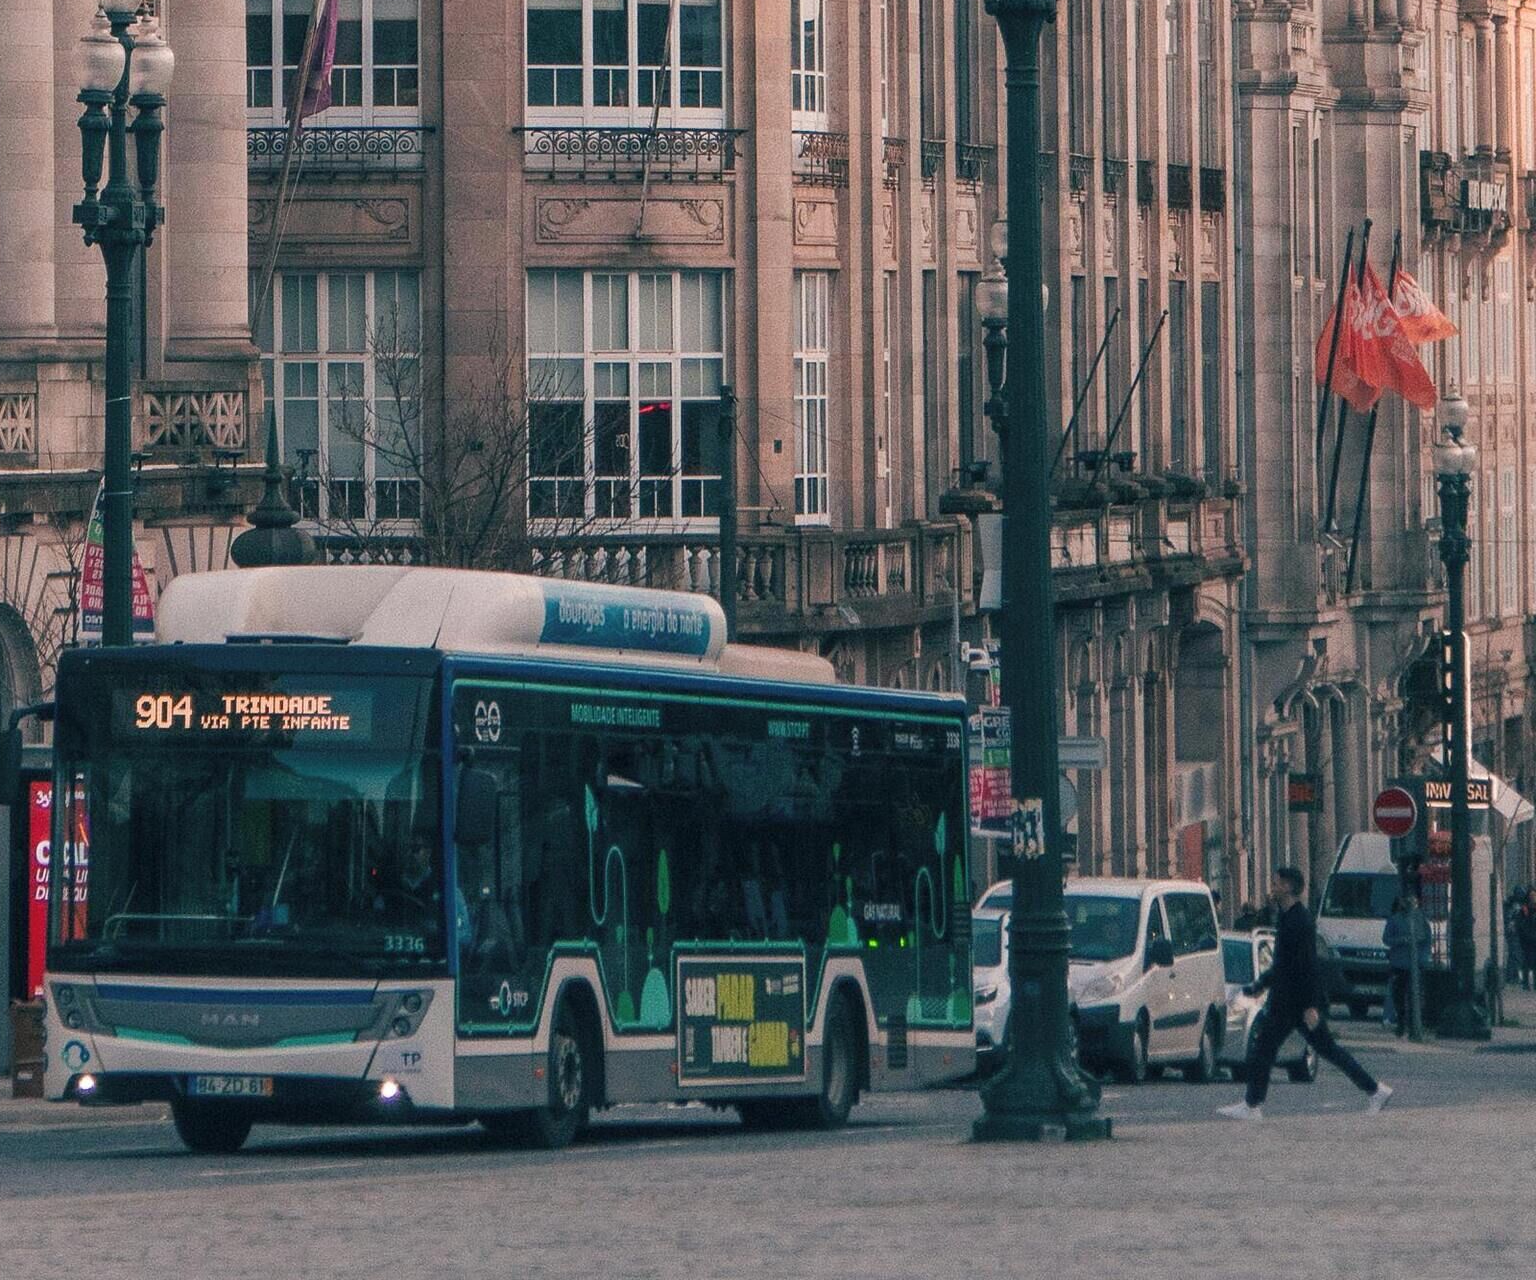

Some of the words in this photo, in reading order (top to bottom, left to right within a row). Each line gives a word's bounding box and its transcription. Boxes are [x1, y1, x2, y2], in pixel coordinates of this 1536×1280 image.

[136, 695, 193, 730] 904
[221, 695, 332, 715] TRINDADE
[201, 715, 229, 730] VIA
[241, 715, 270, 730] PTE
[282, 715, 350, 731] INFANTE
[384, 934, 425, 953] 3336
[201, 1012, 261, 1028] MAN
